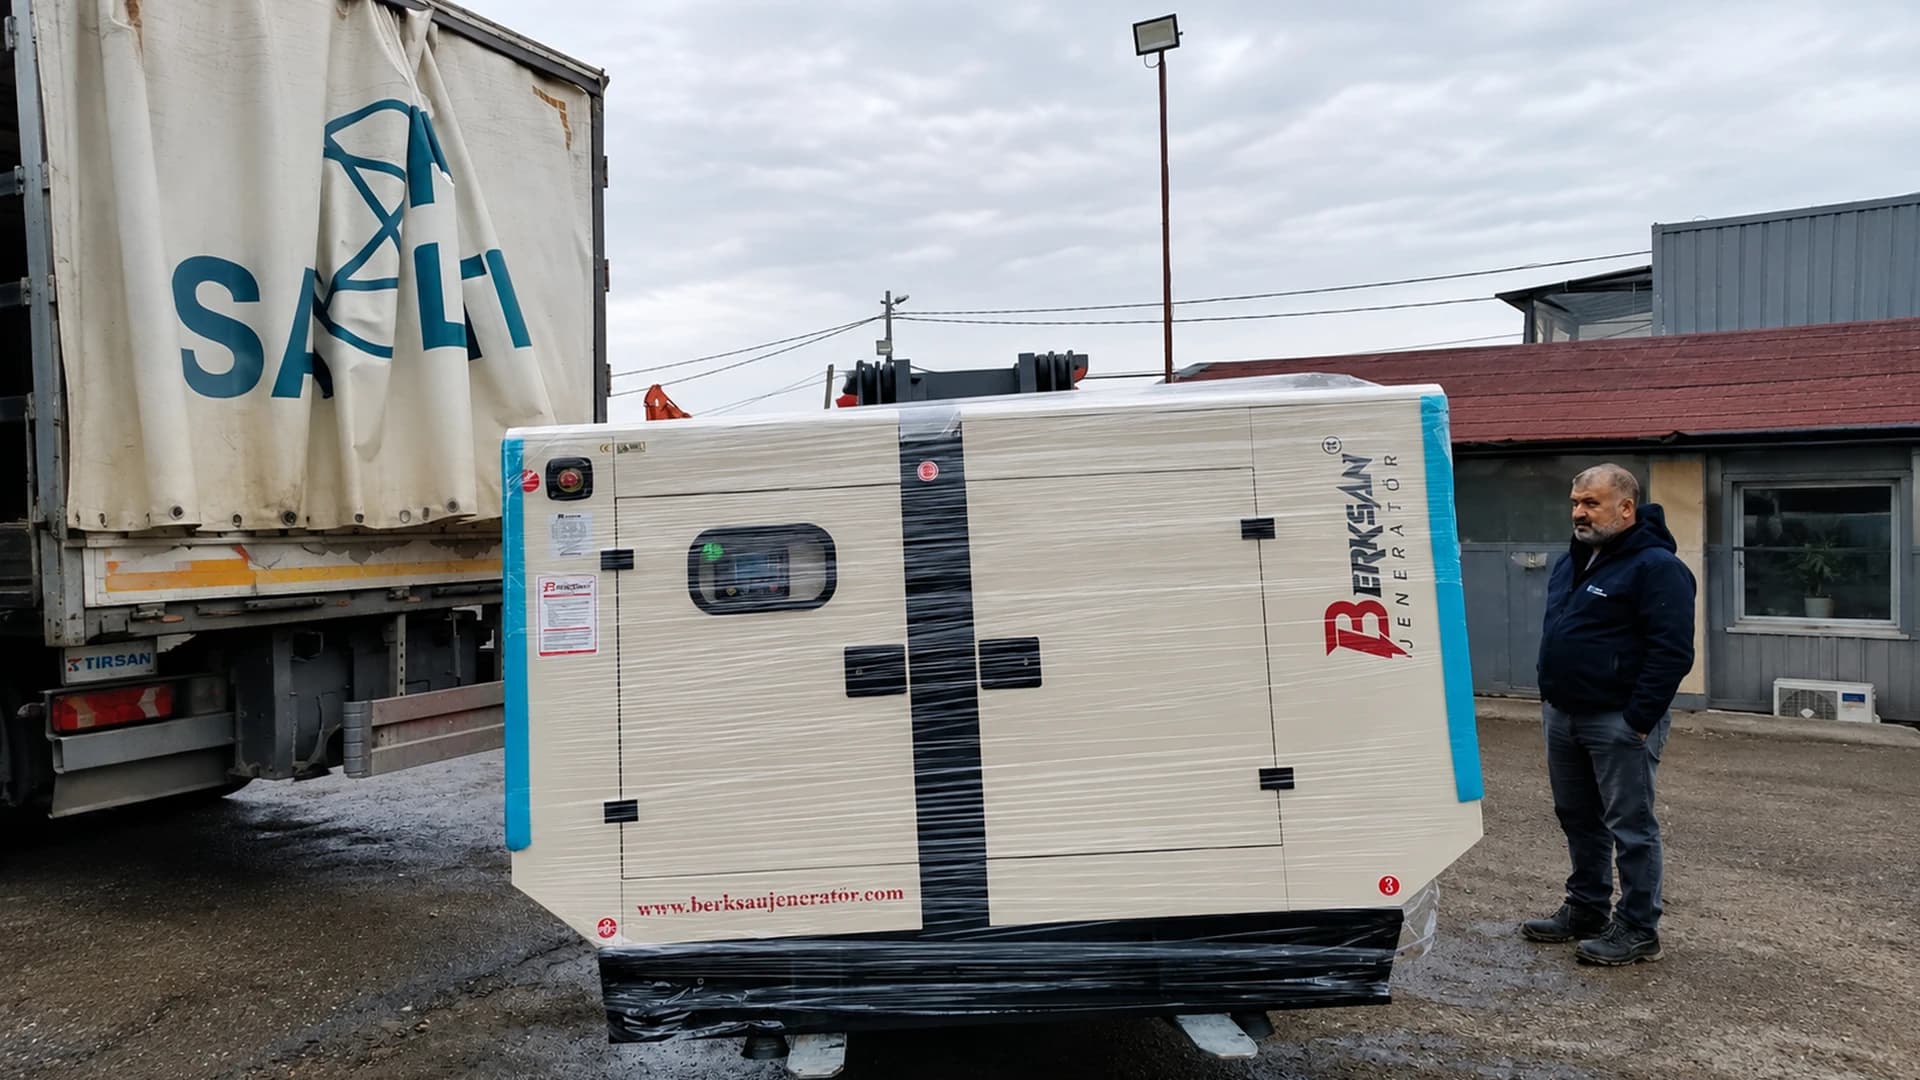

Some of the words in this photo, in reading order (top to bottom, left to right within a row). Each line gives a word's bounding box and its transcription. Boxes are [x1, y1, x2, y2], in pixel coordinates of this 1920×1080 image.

[1324, 453, 1408, 660] BERKSAN
[1381, 455, 1414, 650] JENERATÖR
[85, 652, 152, 670] TIRSAN
